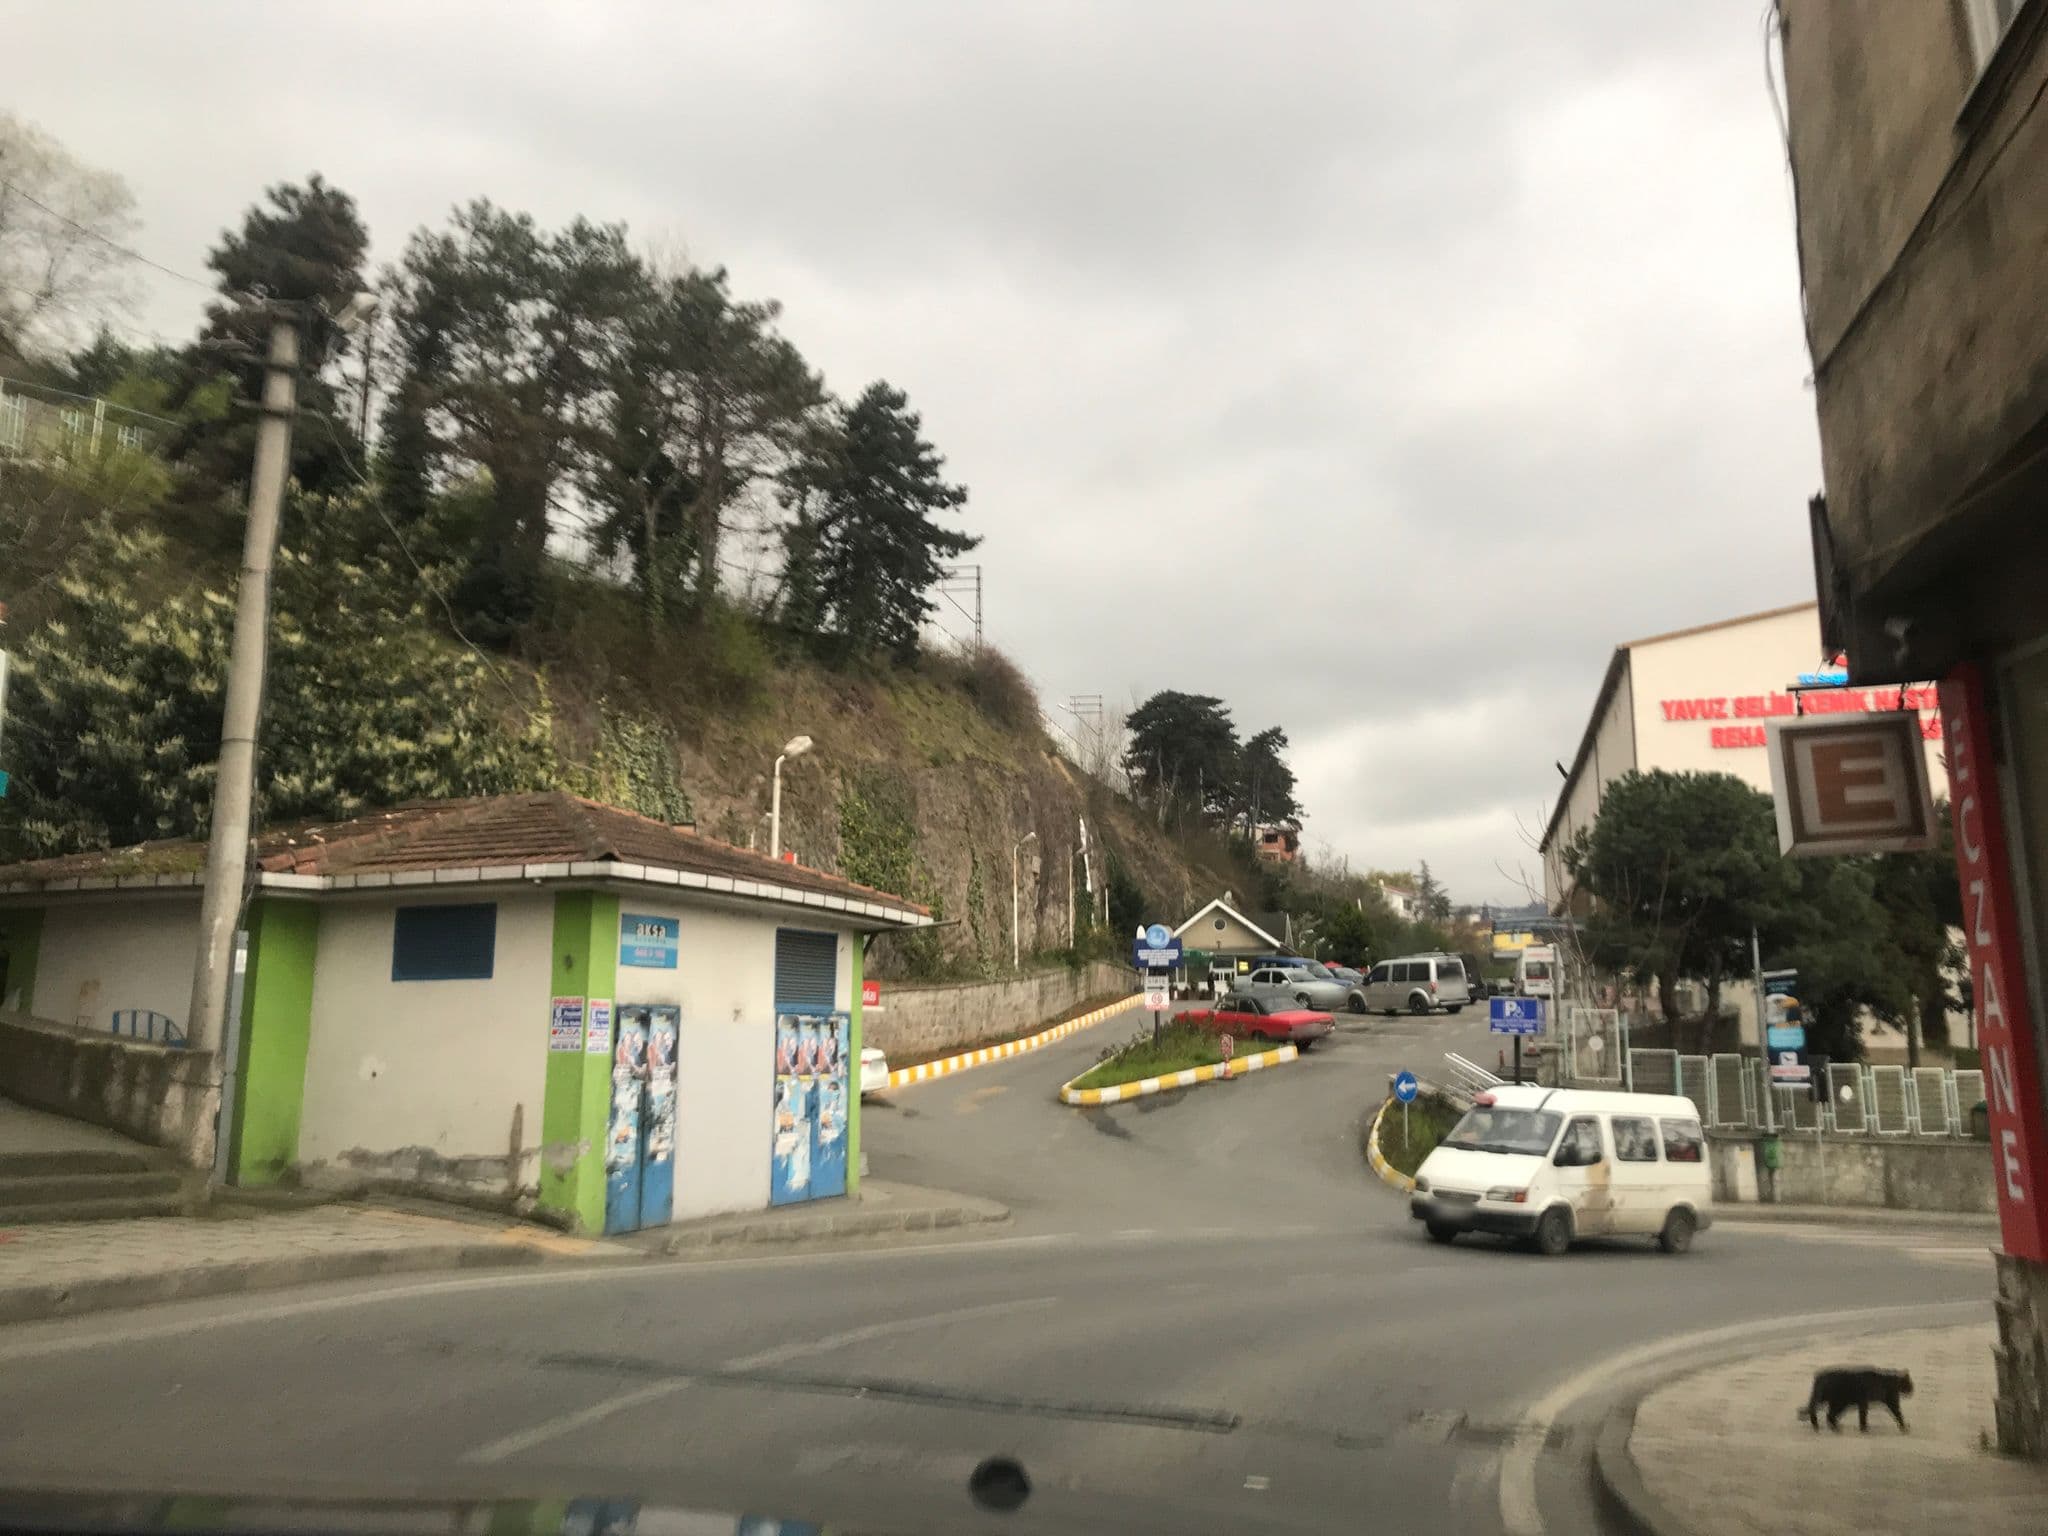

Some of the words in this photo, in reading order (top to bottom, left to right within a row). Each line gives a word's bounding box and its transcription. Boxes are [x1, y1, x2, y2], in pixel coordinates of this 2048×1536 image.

[1661, 698, 1728, 721] YAVUZ
[1733, 690, 1794, 718] SELİM
[1710, 726, 1768, 749] REHA
[1811, 740, 1898, 823] E
[637, 923, 666, 937] aksa
[1951, 718, 2025, 1200] ECZANE
